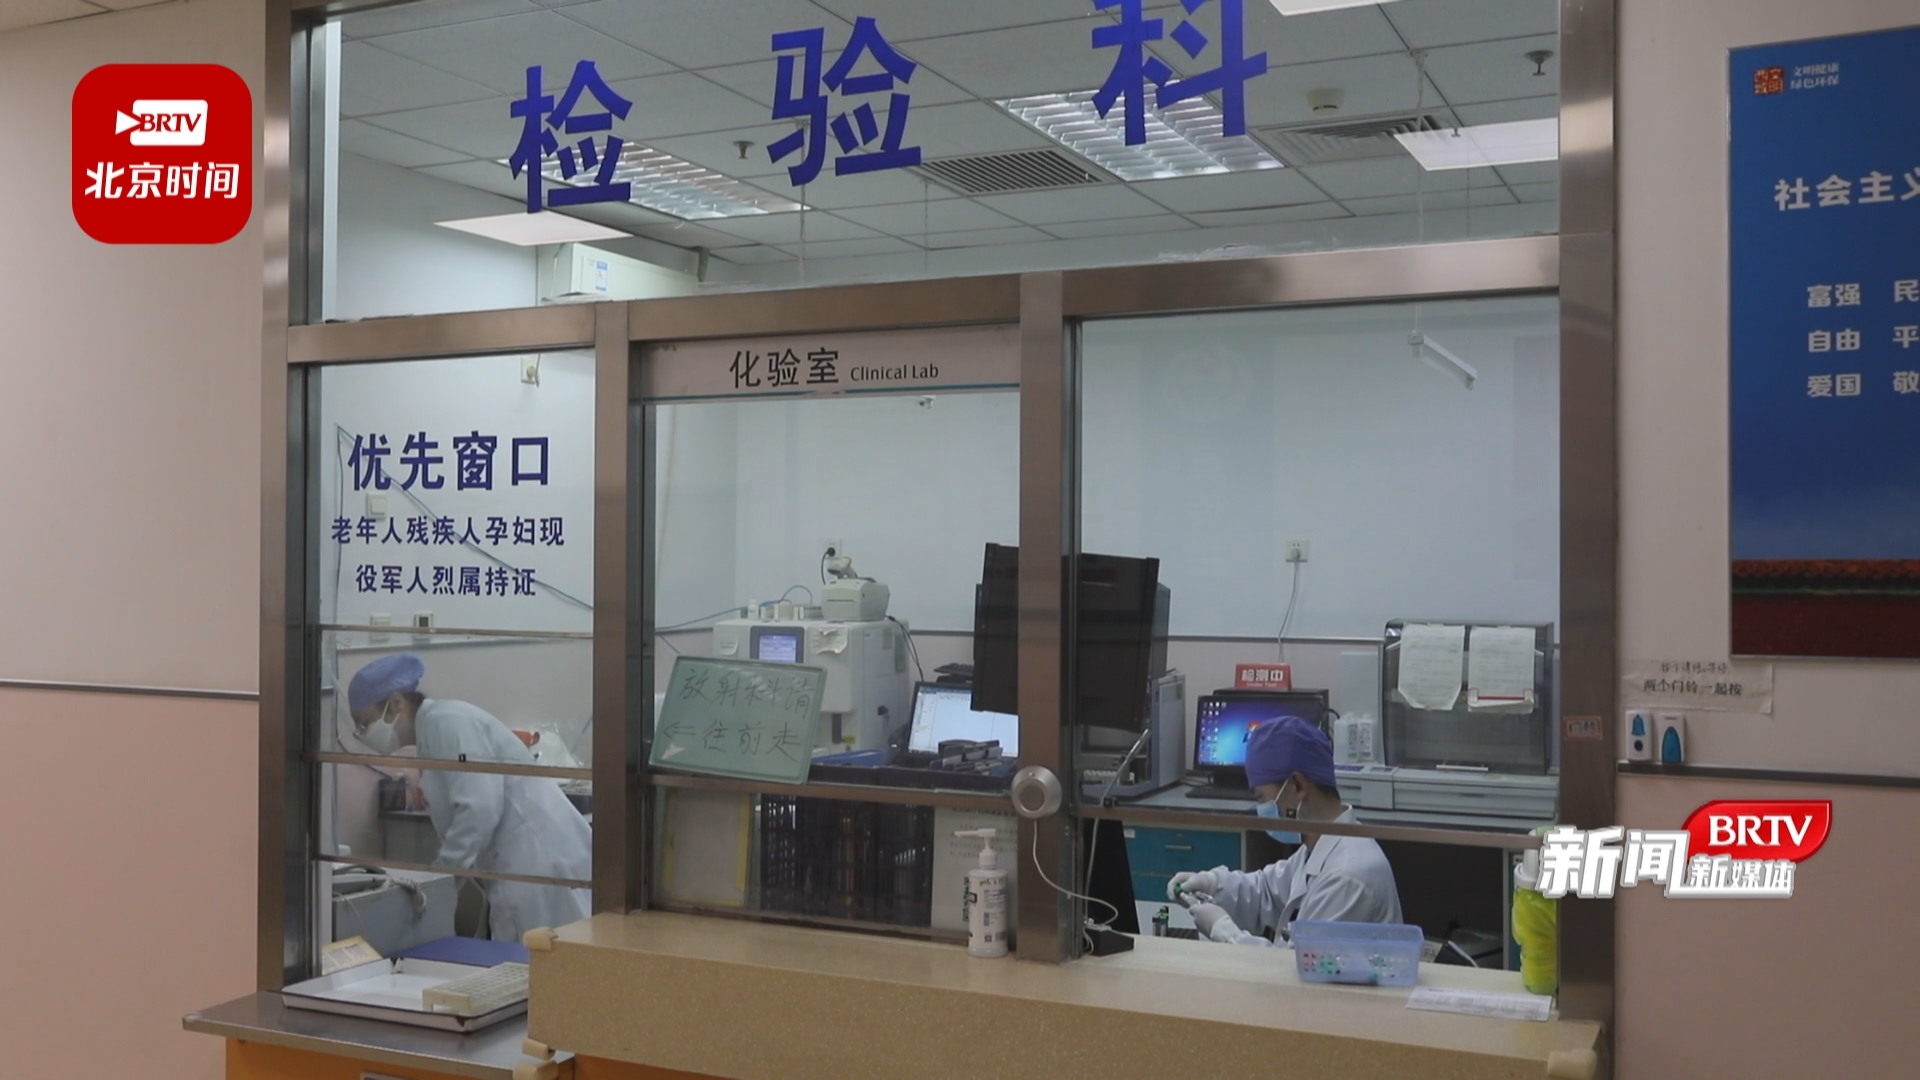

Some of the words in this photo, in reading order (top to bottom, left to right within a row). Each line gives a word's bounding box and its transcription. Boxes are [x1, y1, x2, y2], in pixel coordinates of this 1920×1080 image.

[1790, 75, 1840, 89] 绿色环保
[510, 0, 1268, 212] 检验科
[1807, 283, 1861, 308] 富强
[1893, 279, 1919, 303] 民
[1808, 328, 1861, 353] 自由
[1892, 325, 1919, 349] 平
[729, 347, 840, 390] 化验室
[850, 365, 908, 382] Clinical
[911, 363, 939, 380] Lab
[1807, 373, 1861, 398] 爱国
[1892, 370, 1919, 395] 敬
[347, 429, 549, 491] 优先窗口
[331, 515, 565, 546] 老年人残疾人孕妇现
[356, 564, 537, 597] 役军人烈属持证
[1241, 668, 1284, 682] 检测中
[1643, 679, 1742, 696] 两个门铃一起按
[680, 668, 814, 719] 放射科请
[703, 720, 802, 762] 往前走
